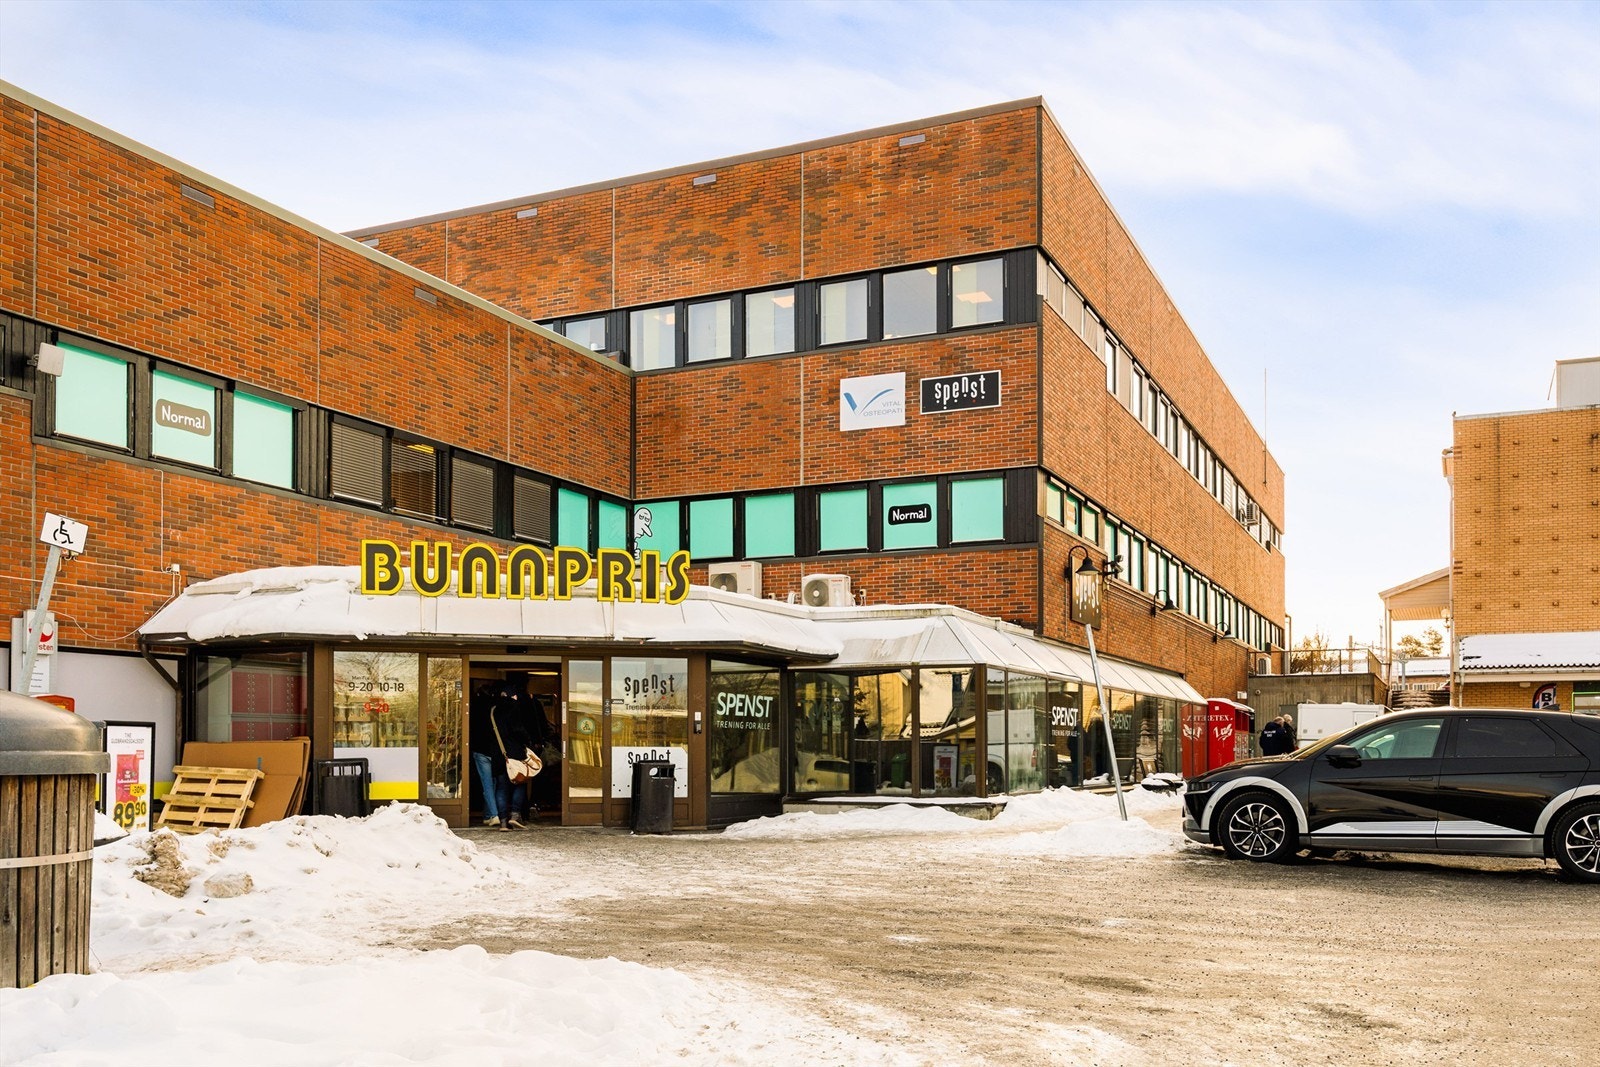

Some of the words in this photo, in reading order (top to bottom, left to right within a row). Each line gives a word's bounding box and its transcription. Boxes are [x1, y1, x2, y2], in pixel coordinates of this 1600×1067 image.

[934, 374, 985, 408] spenst
[161, 405, 206, 430] Normal
[863, 408, 903, 417] OSTEOPATI
[892, 507, 927, 521] Normal
[361, 539, 691, 606] BUNNPRIS
[348, 682, 374, 692] 9-20
[379, 682, 405, 692] 10-18
[624, 674, 675, 702] spenst
[716, 691, 774, 718] SPENST
[716, 720, 744, 729] TRENING
[745, 721, 757, 730] FOR
[757, 722, 771, 730] ALLE
[1051, 706, 1079, 727] SPENST
